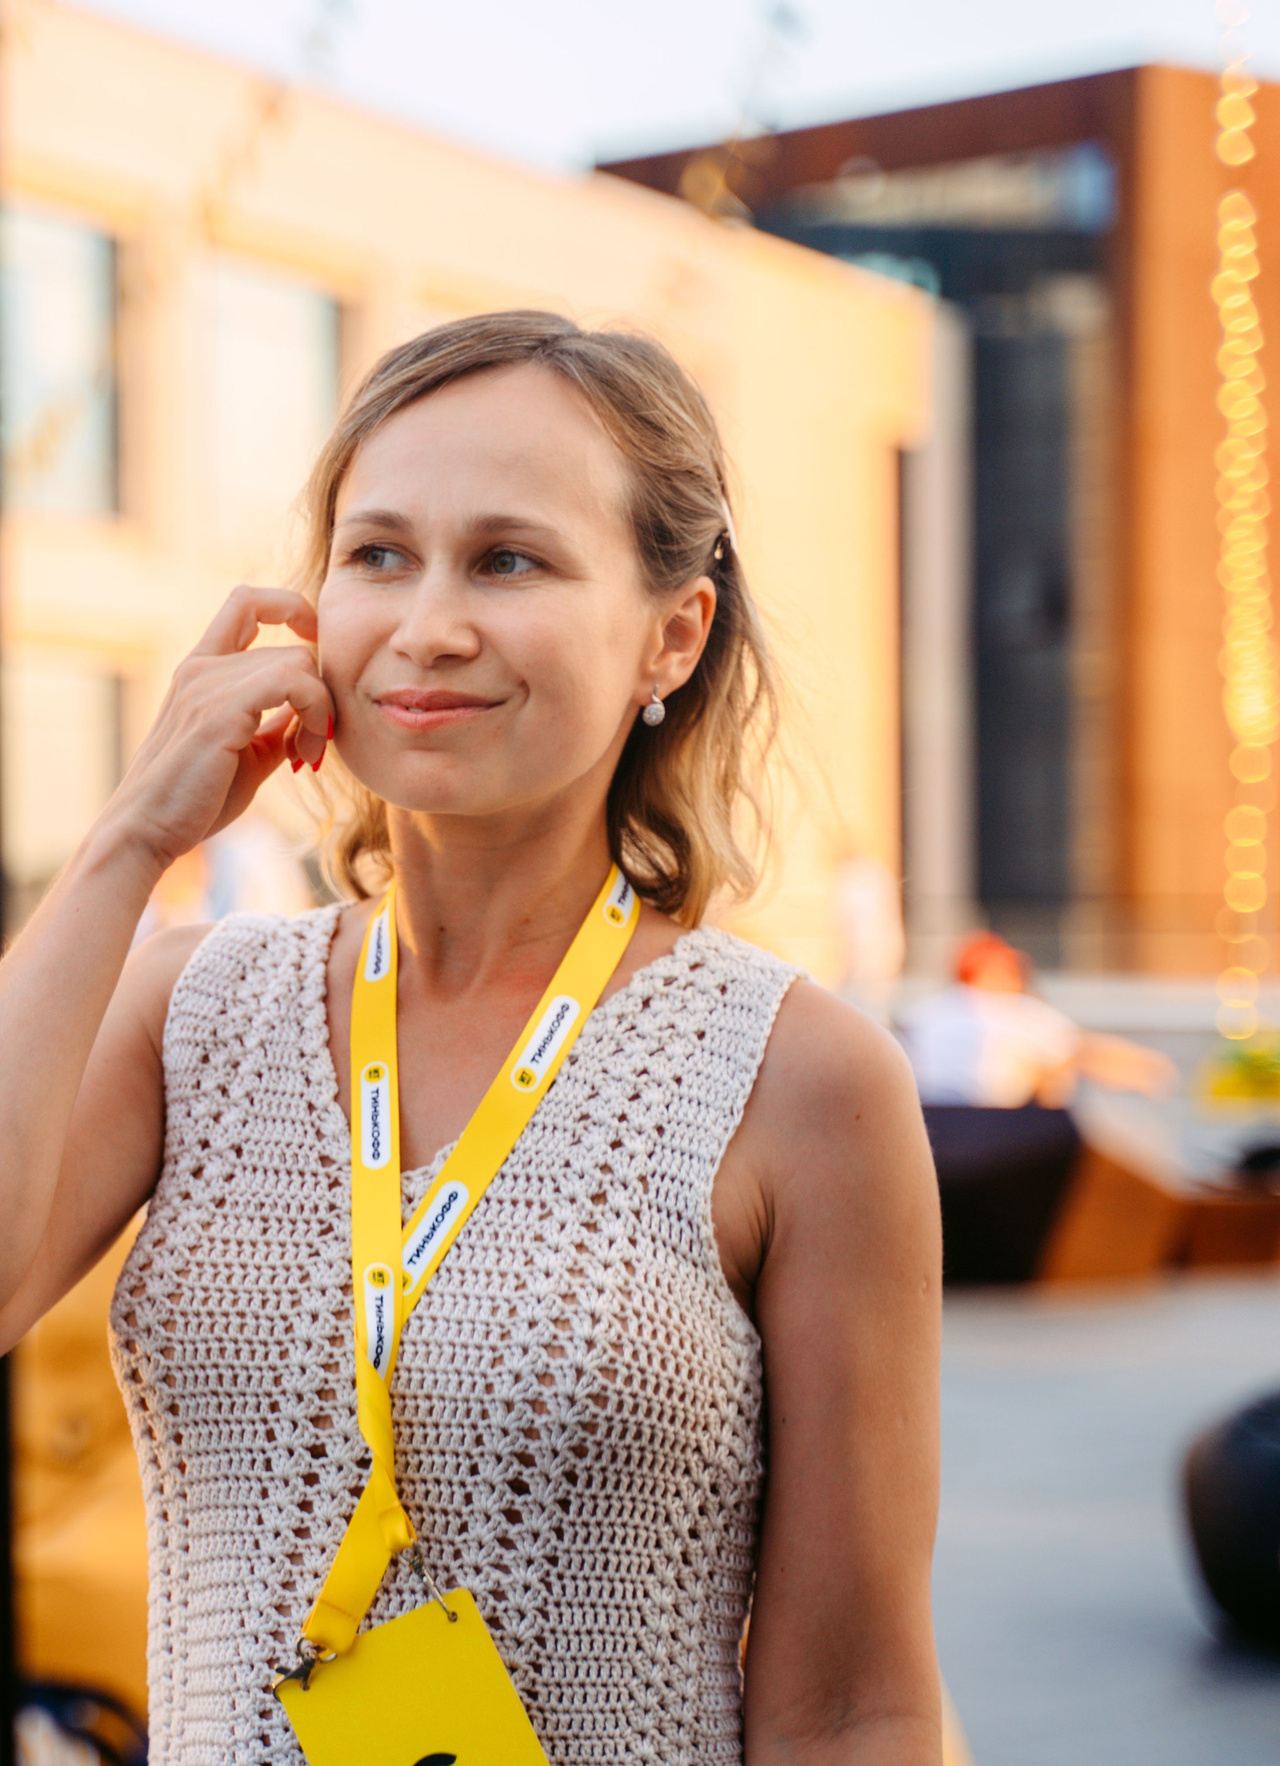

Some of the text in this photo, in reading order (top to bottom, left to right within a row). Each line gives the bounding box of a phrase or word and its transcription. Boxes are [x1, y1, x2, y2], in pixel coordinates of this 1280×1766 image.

[530, 1003, 570, 1066] ТИНЬКОФФ
[371, 1087, 381, 1161] ТИНЬКОФФ
[406, 1190, 459, 1267] ТИНЬКОФФ
[373, 1294, 385, 1370] ТИНЬКОФ
